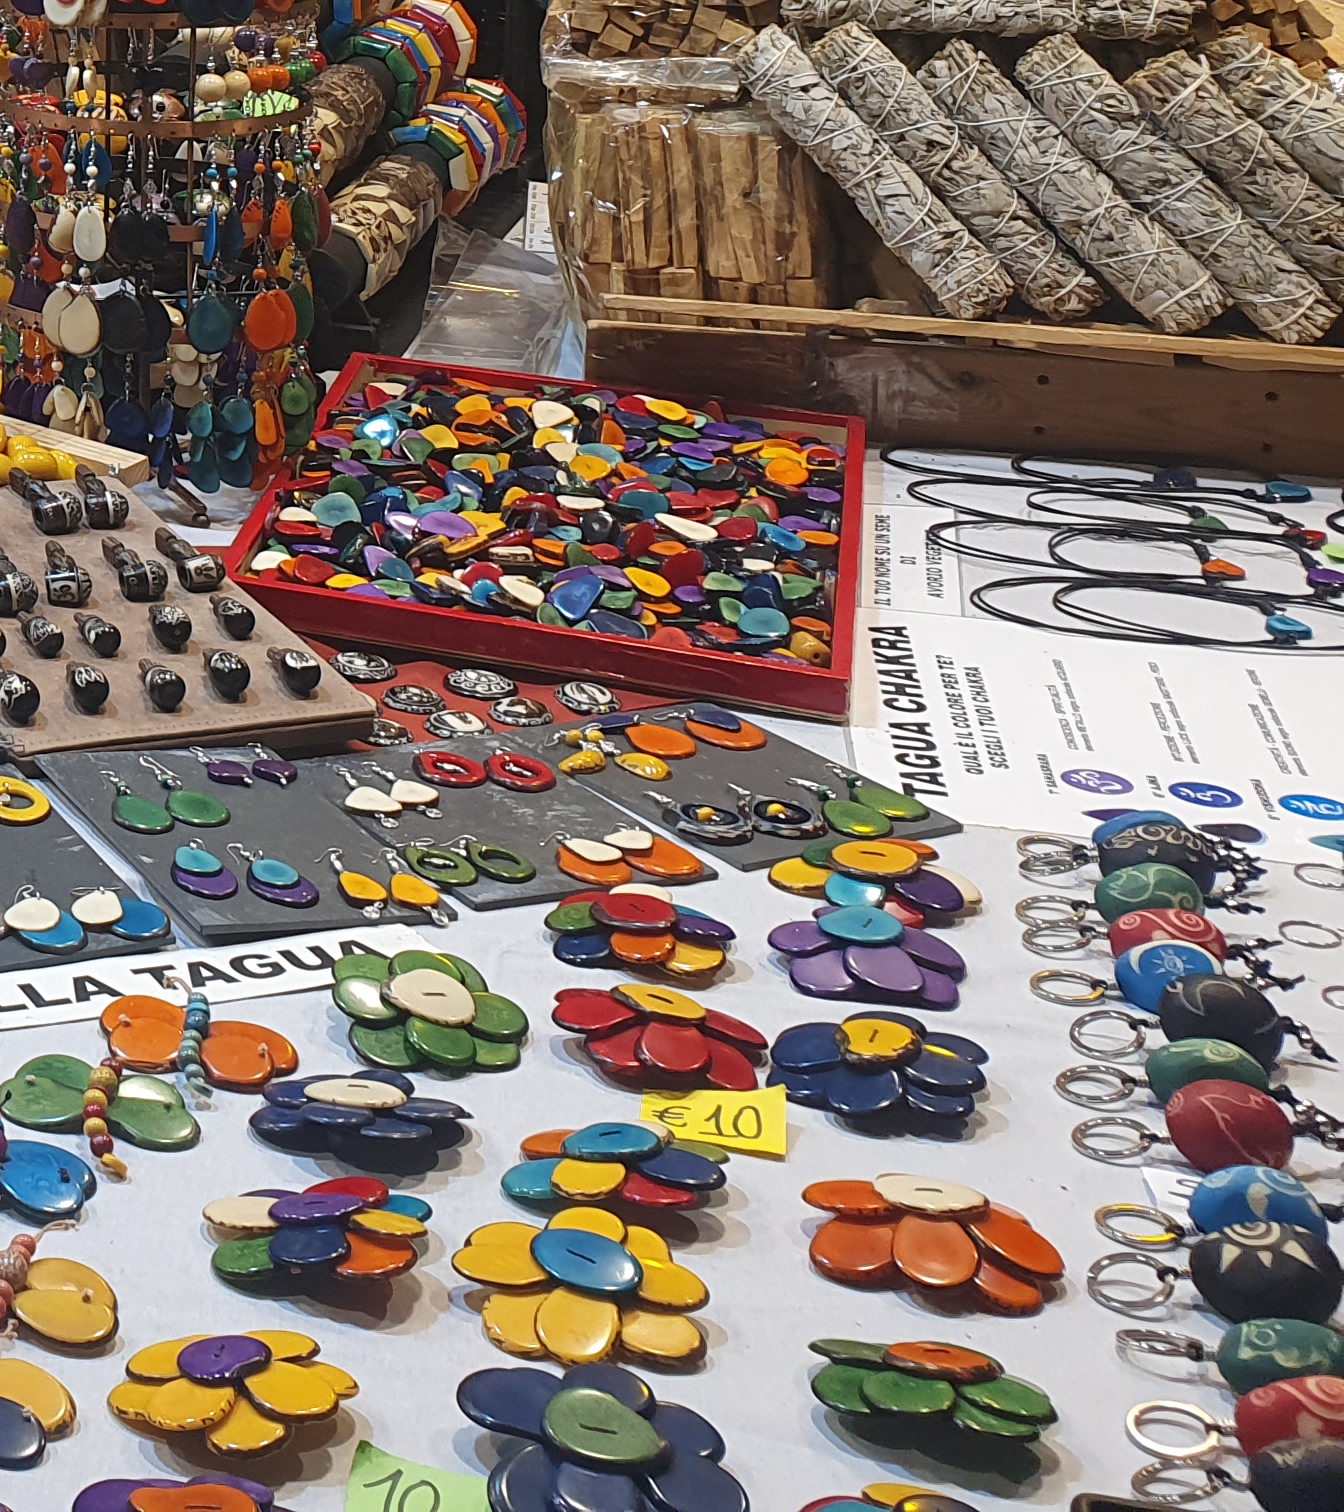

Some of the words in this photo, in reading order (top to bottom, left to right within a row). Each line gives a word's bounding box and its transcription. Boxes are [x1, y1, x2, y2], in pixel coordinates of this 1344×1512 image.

[874, 514, 891, 533] SEME
[874, 545, 891, 556] SU
[899, 555, 917, 566] DI
[874, 557, 891, 579] NOME
[874, 579, 891, 596] TUO
[925, 567, 945, 600] AVORIO
[874, 597, 892, 607] IL
[867, 625, 928, 714] CHAKRA
[935, 654, 956, 670] TE?
[939, 672, 961, 691] PER
[962, 666, 991, 704] CHAKRA
[944, 691, 970, 729] COLORE
[973, 705, 998, 727] TUOI
[887, 722, 949, 798] TAGUA
[959, 751, 985, 776] QUAL
[983, 736, 1010, 770] SCEGLI
[131, 939, 393, 991] TAGUA
